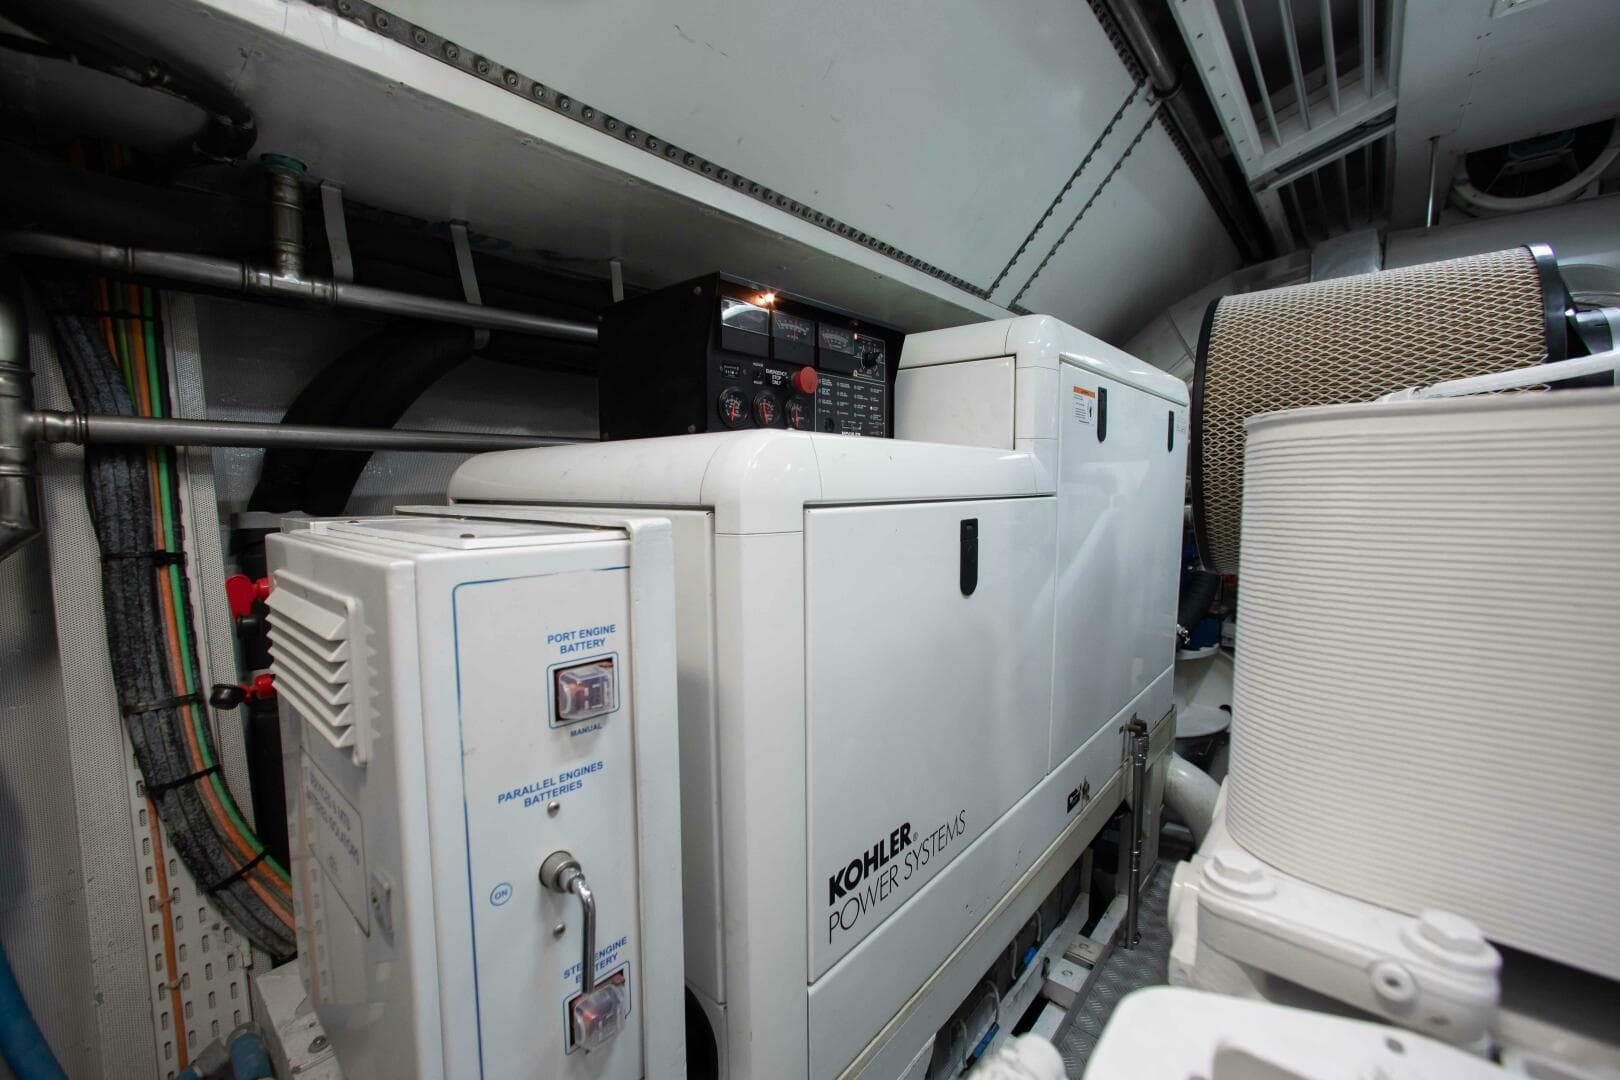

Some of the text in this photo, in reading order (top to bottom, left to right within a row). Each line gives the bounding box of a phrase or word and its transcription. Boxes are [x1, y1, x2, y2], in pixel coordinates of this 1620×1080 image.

[547, 624, 617, 645] PORT ENGINE
[560, 638, 606, 654] BATTERY
[571, 724, 602, 737] MANUAL
[497, 761, 604, 805] PARALLEL ENGINES
[524, 780, 583, 807] BATTERIES
[829, 809, 967, 945] POWER SYSTEMS
[495, 890, 508, 900] ON
[576, 952, 618, 983] BTERY
